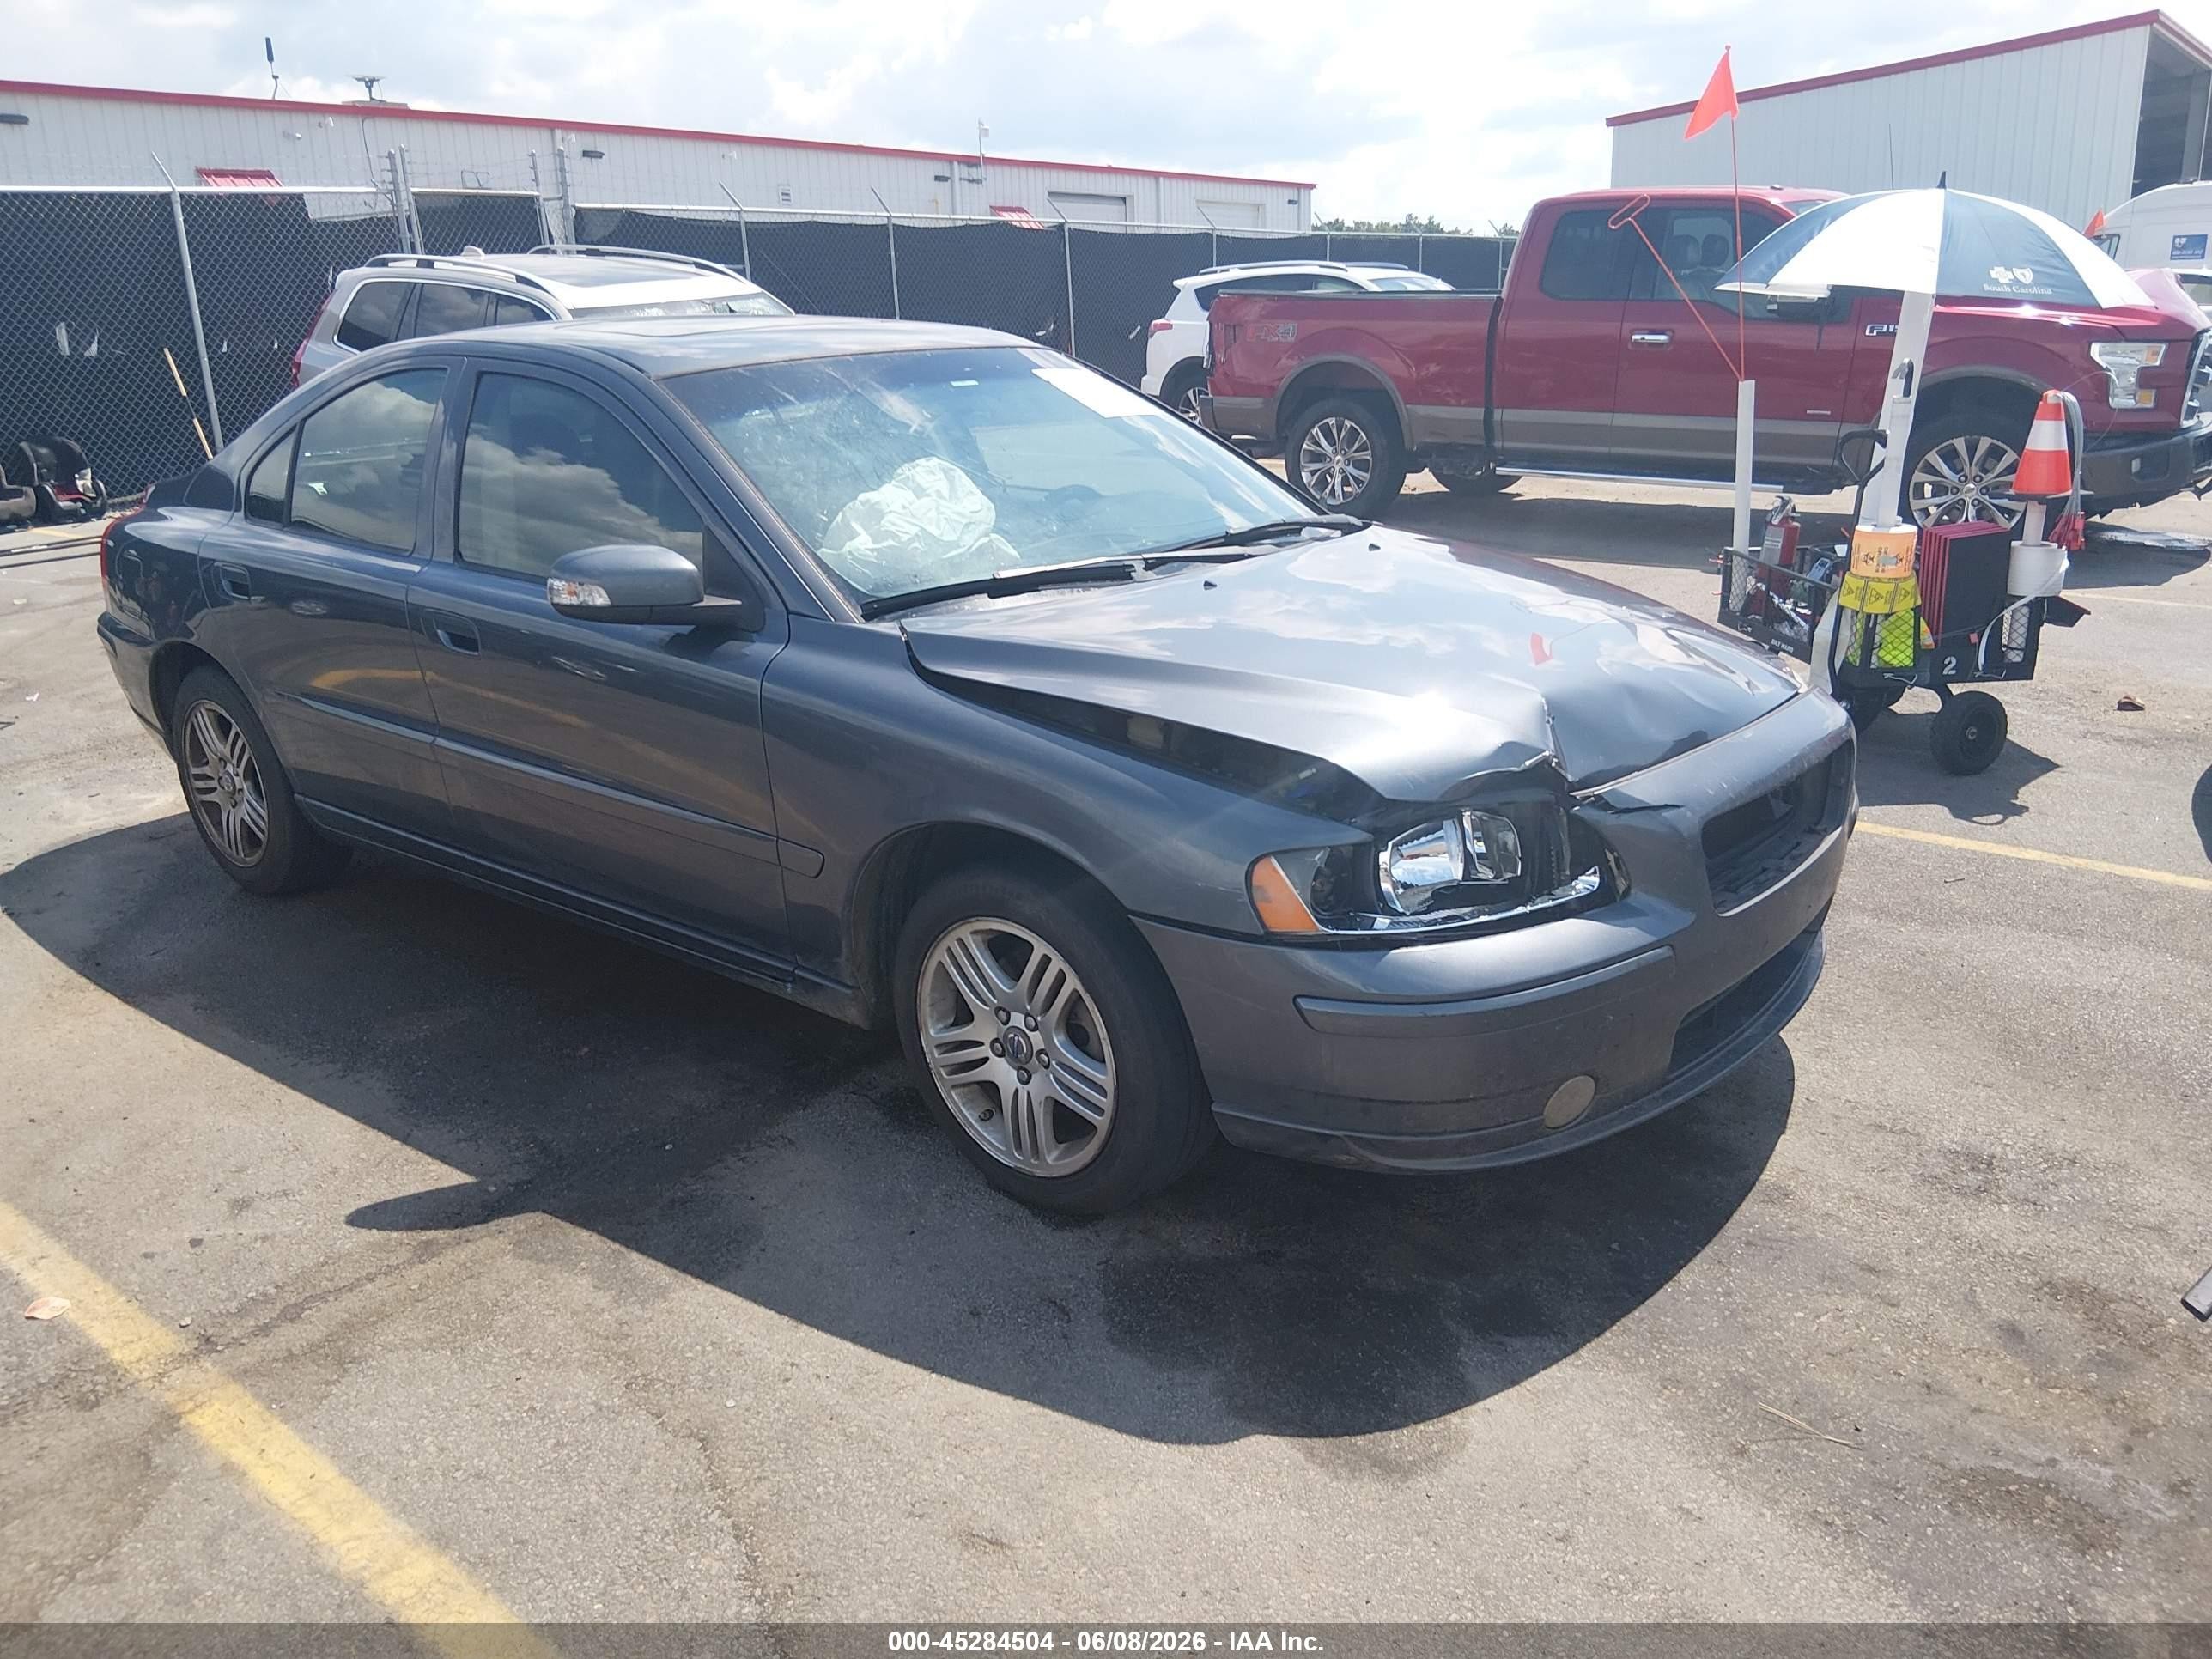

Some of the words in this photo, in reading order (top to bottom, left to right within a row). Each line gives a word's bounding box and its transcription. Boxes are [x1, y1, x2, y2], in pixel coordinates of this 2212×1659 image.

[1983, 283, 2011, 292] South
[2012, 286, 2053, 295] Carolina
[1246, 323, 1297, 341] FX4
[1942, 655, 1957, 675] 2
